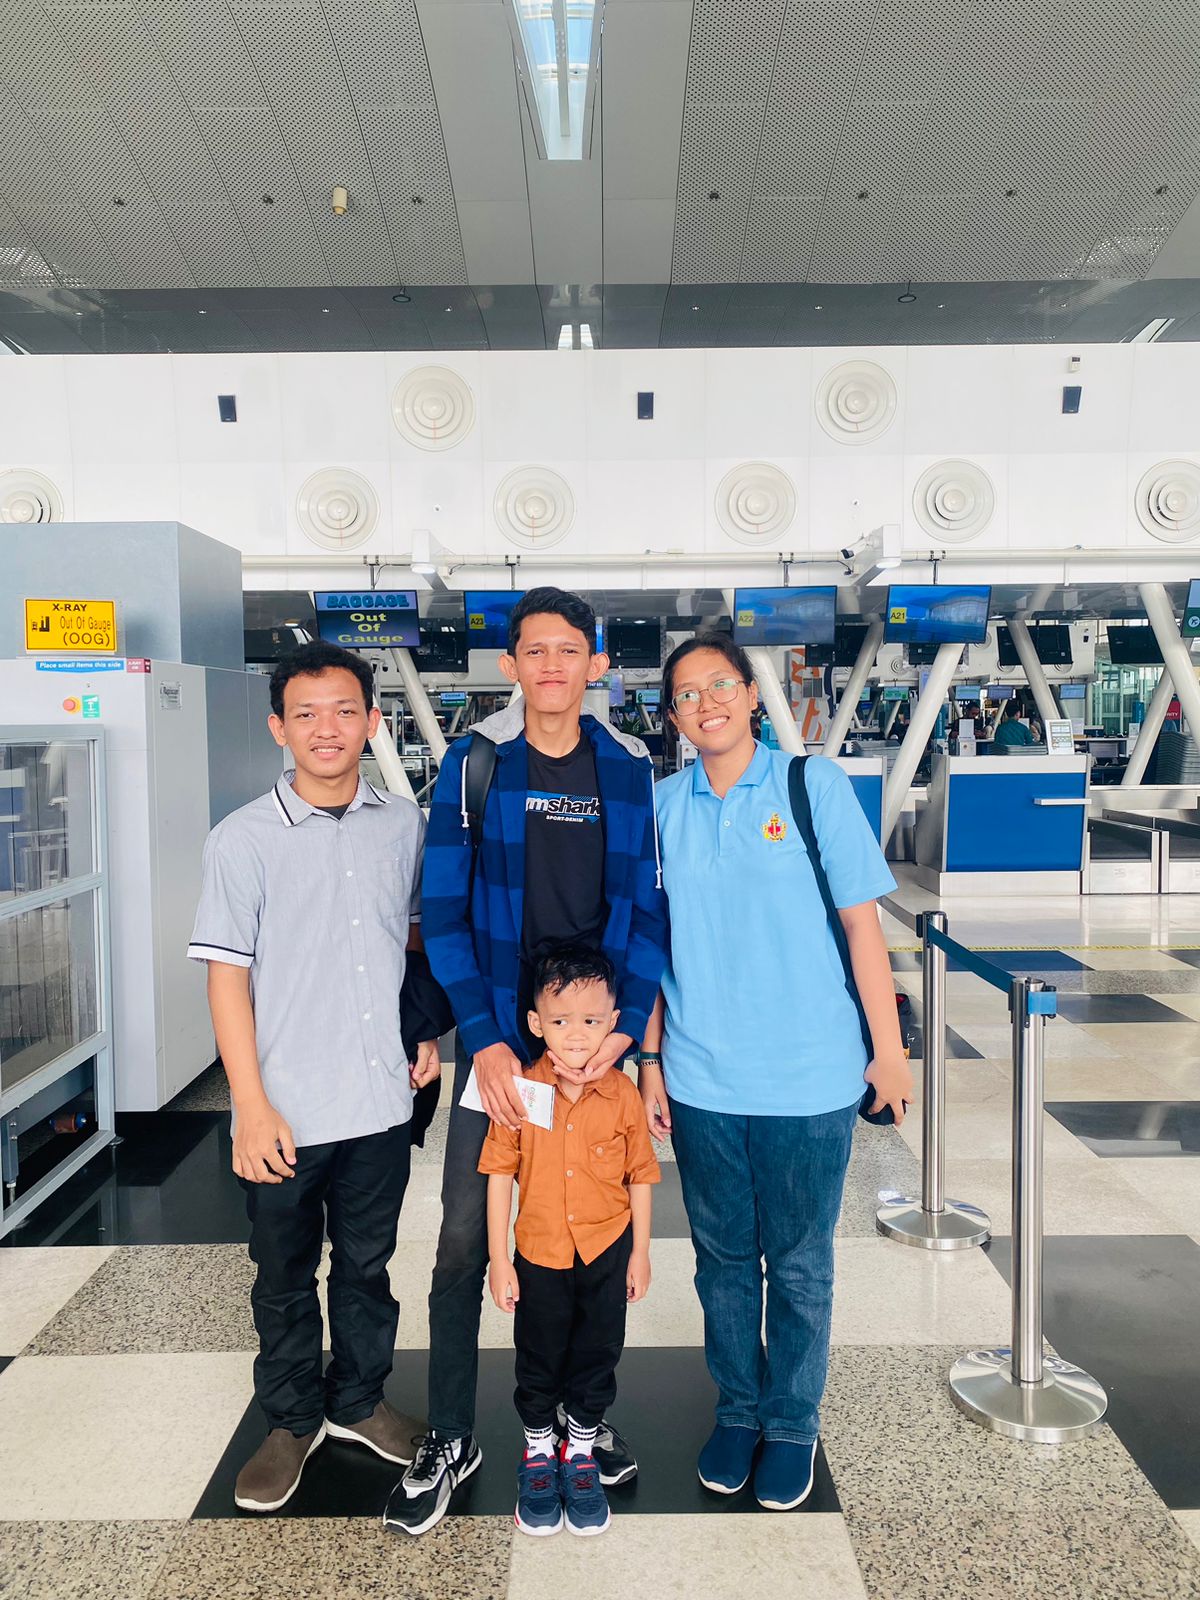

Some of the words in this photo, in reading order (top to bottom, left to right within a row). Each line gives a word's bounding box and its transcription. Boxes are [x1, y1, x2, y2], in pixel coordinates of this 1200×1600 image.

[327, 594, 409, 608] BAGGAGE
[52, 603, 87, 612] X-RAY
[350, 613, 387, 622] Out
[890, 612, 905, 620] A21
[60, 615, 73, 629] Out
[76, 616, 85, 629] Of
[88, 616, 111, 632] Gauge
[470, 617, 484, 625] A23
[357, 623, 381, 632] Of
[63, 632, 110, 647] (OOG)
[338, 634, 403, 645] Gauge
[546, 815, 584, 823] SPORT-DENIM
